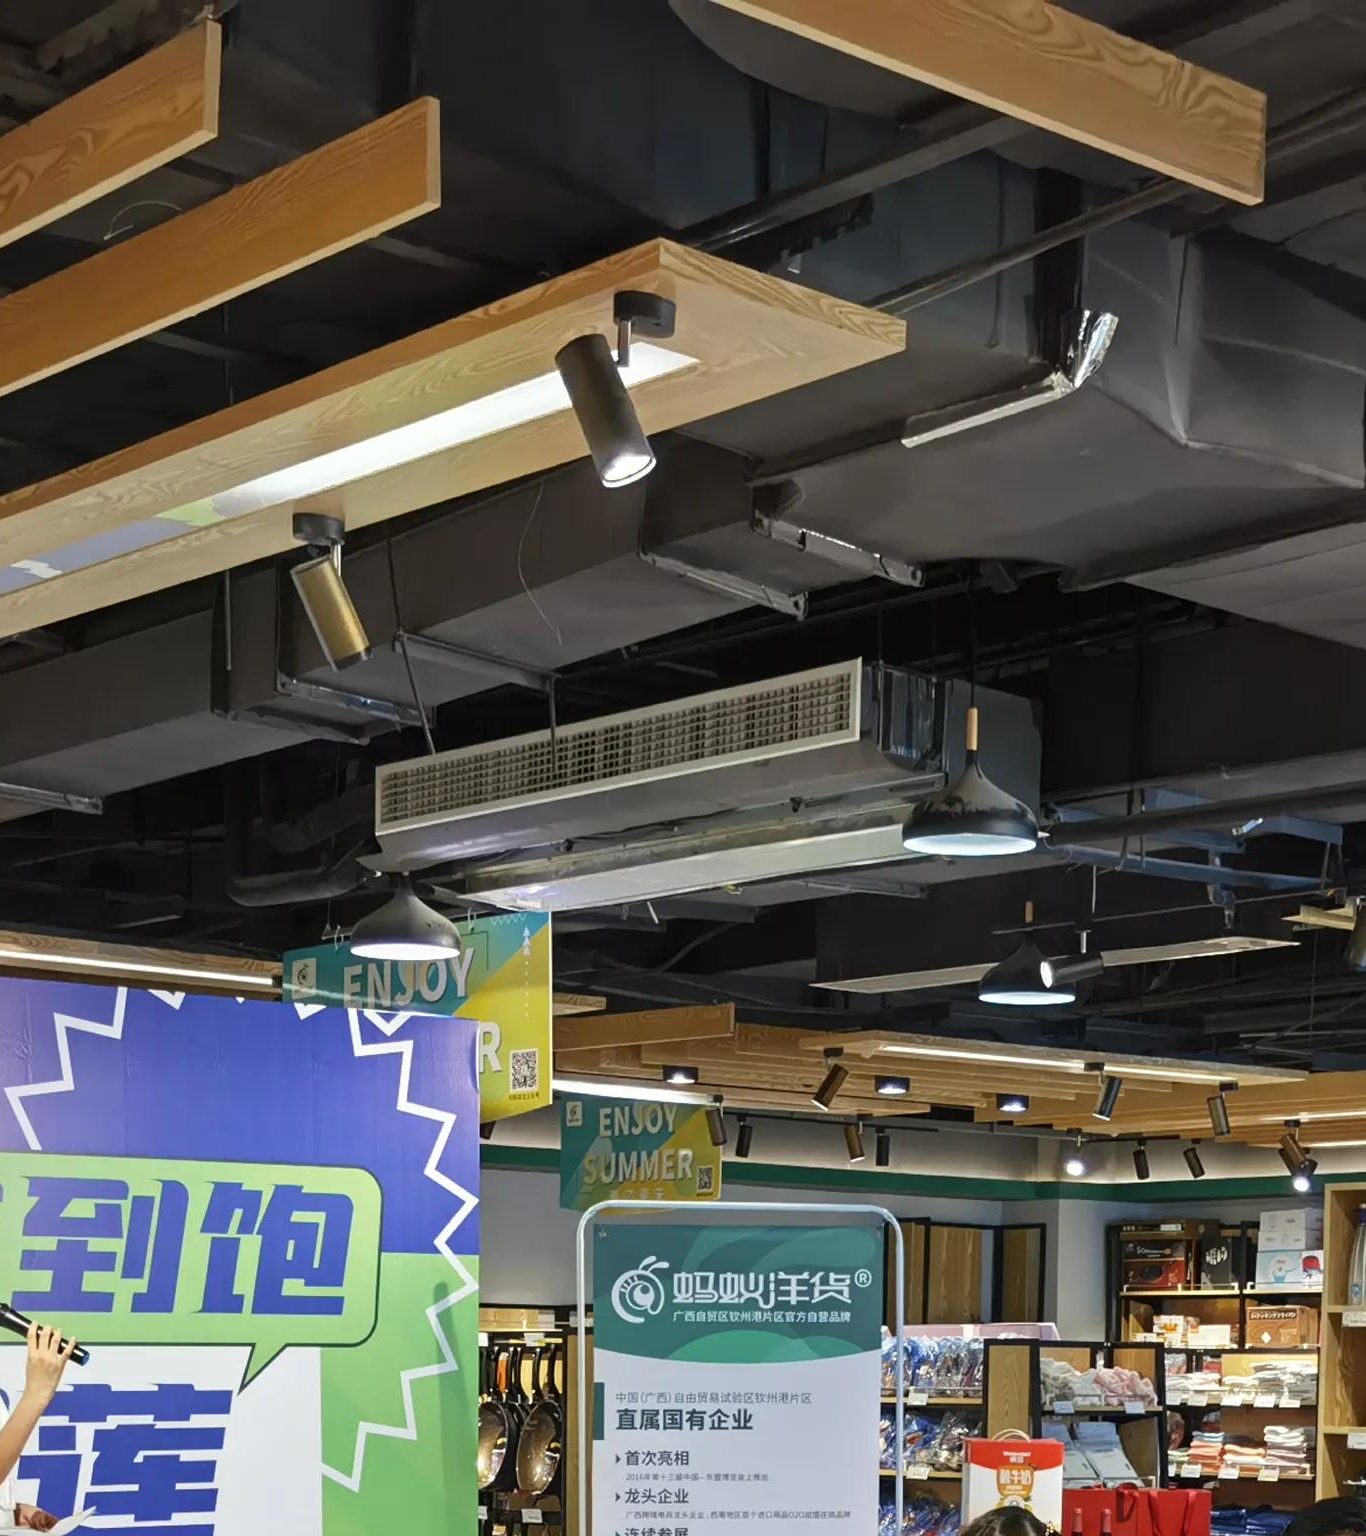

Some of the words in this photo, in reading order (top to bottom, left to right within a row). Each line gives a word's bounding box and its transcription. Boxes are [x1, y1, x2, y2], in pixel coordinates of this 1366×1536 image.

[343, 948, 475, 1009] ENJOY
[599, 1104, 678, 1137] ENJOY
[584, 1149, 694, 1184] SUMMER
[673, 1310, 851, 1324] 广西自贸区钦州港片区官方自营品牌
[616, 1409, 754, 1431] 直属国有企业
[625, 1451, 690, 1466] 首次亮相
[625, 1489, 690, 1504] 龙头企业
